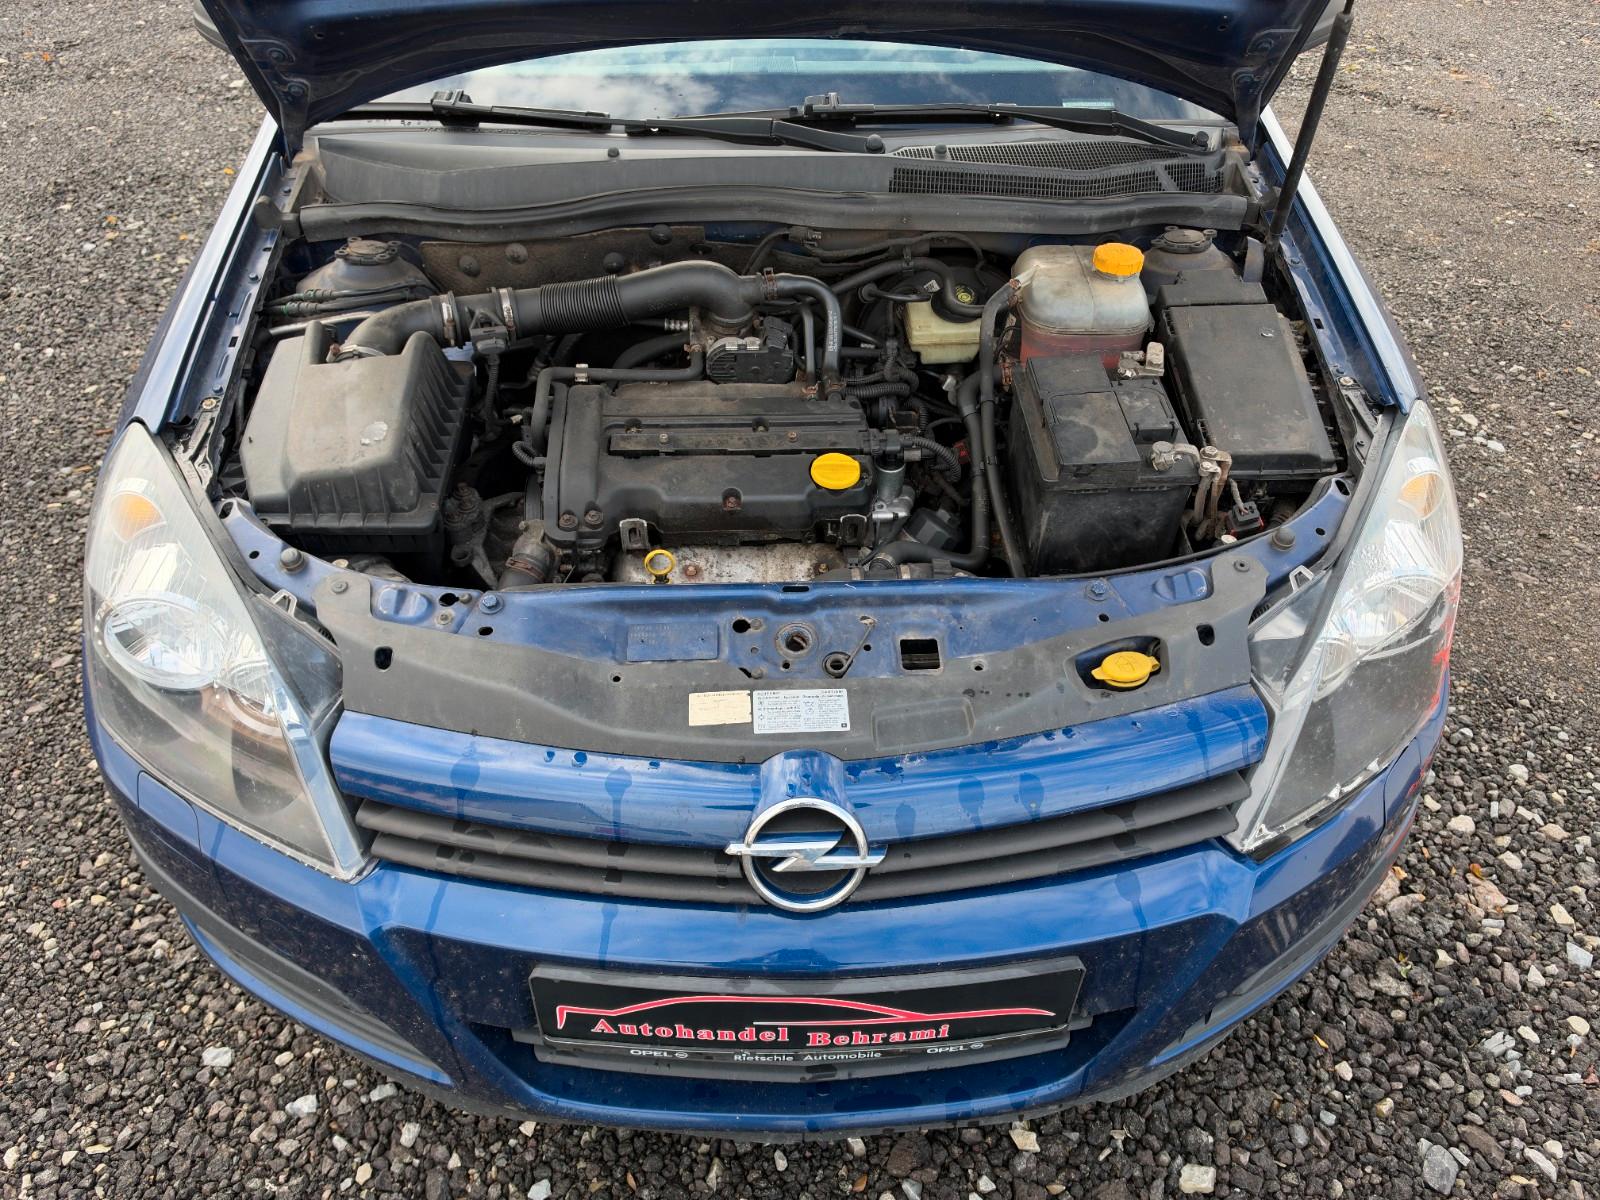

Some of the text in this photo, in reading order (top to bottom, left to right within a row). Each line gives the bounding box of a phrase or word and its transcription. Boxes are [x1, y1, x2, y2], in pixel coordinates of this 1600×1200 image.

[591, 1018, 950, 1047] Autohandel Behrami
[629, 1049, 673, 1058] OPEL
[926, 1044, 968, 1054] OPEL
[733, 1051, 882, 1062] Rietschle Automobile
